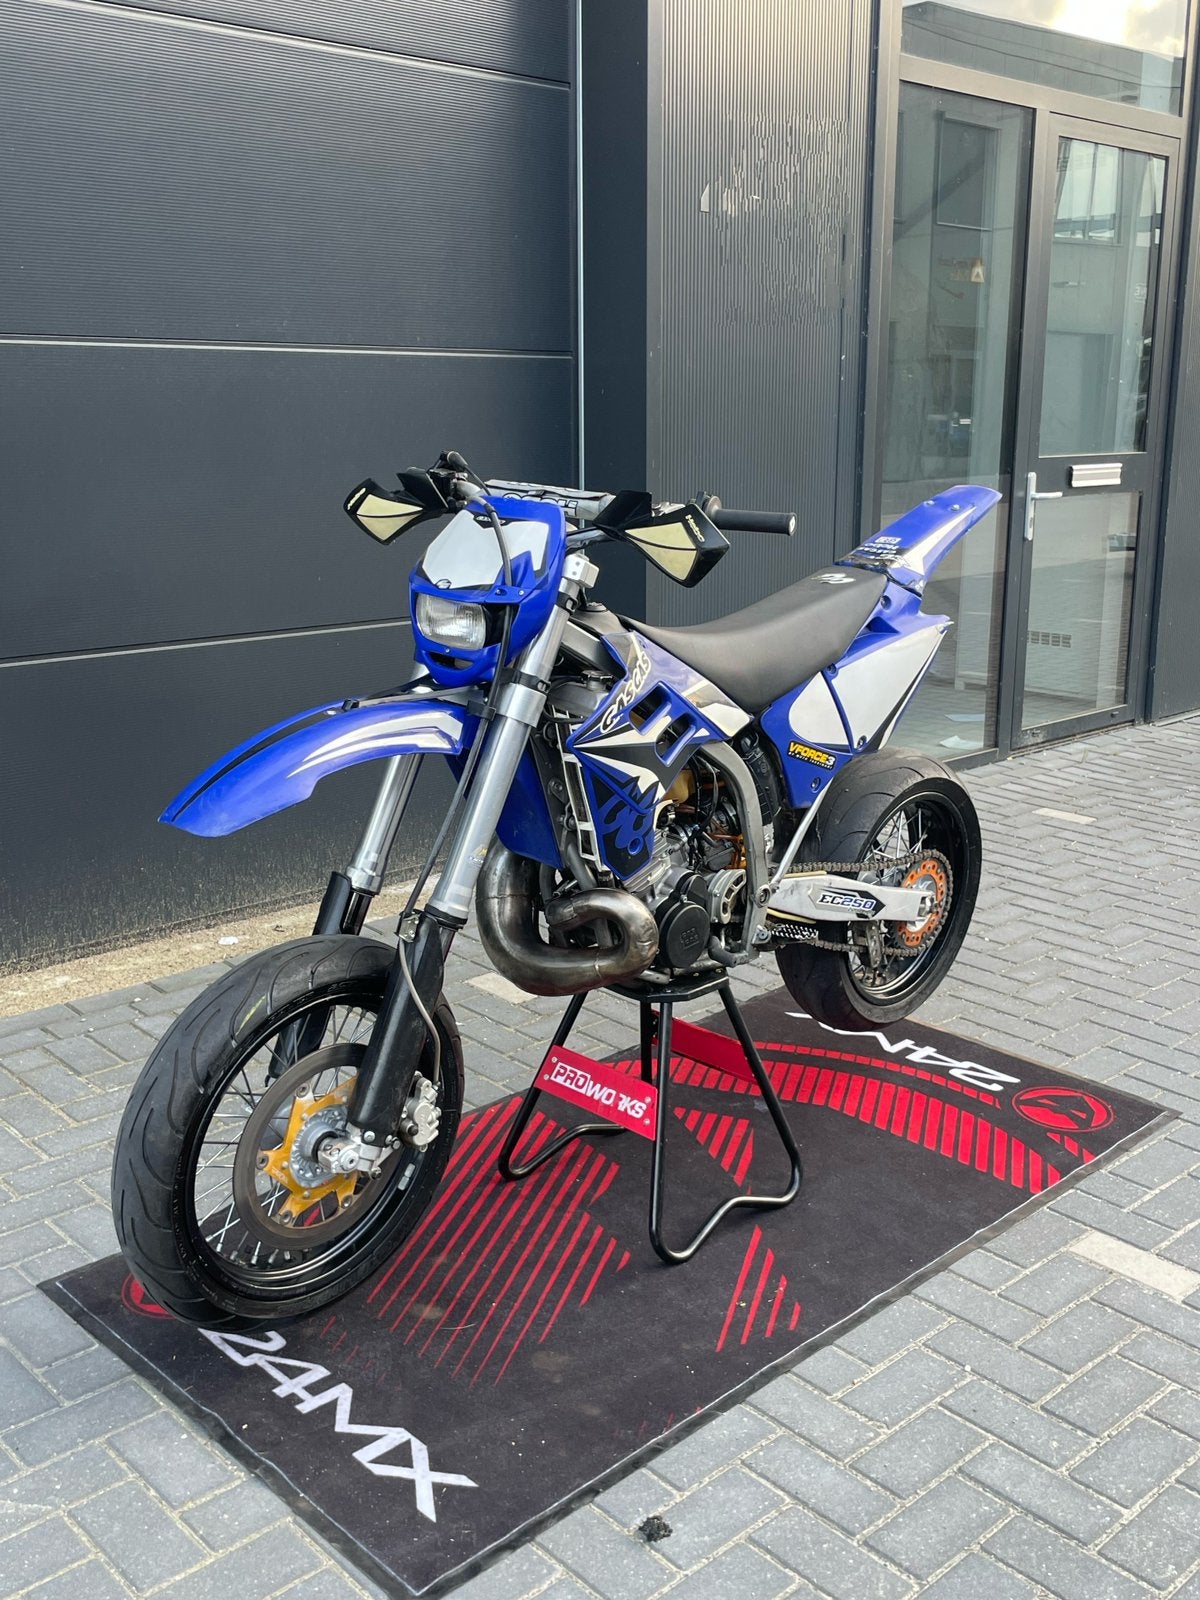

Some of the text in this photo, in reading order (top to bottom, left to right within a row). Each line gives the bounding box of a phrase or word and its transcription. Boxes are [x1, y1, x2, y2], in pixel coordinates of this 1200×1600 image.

[789, 741, 836, 765] VFORCE3
[817, 893, 877, 910] EC250
[198, 1327, 480, 1523] 24MX
